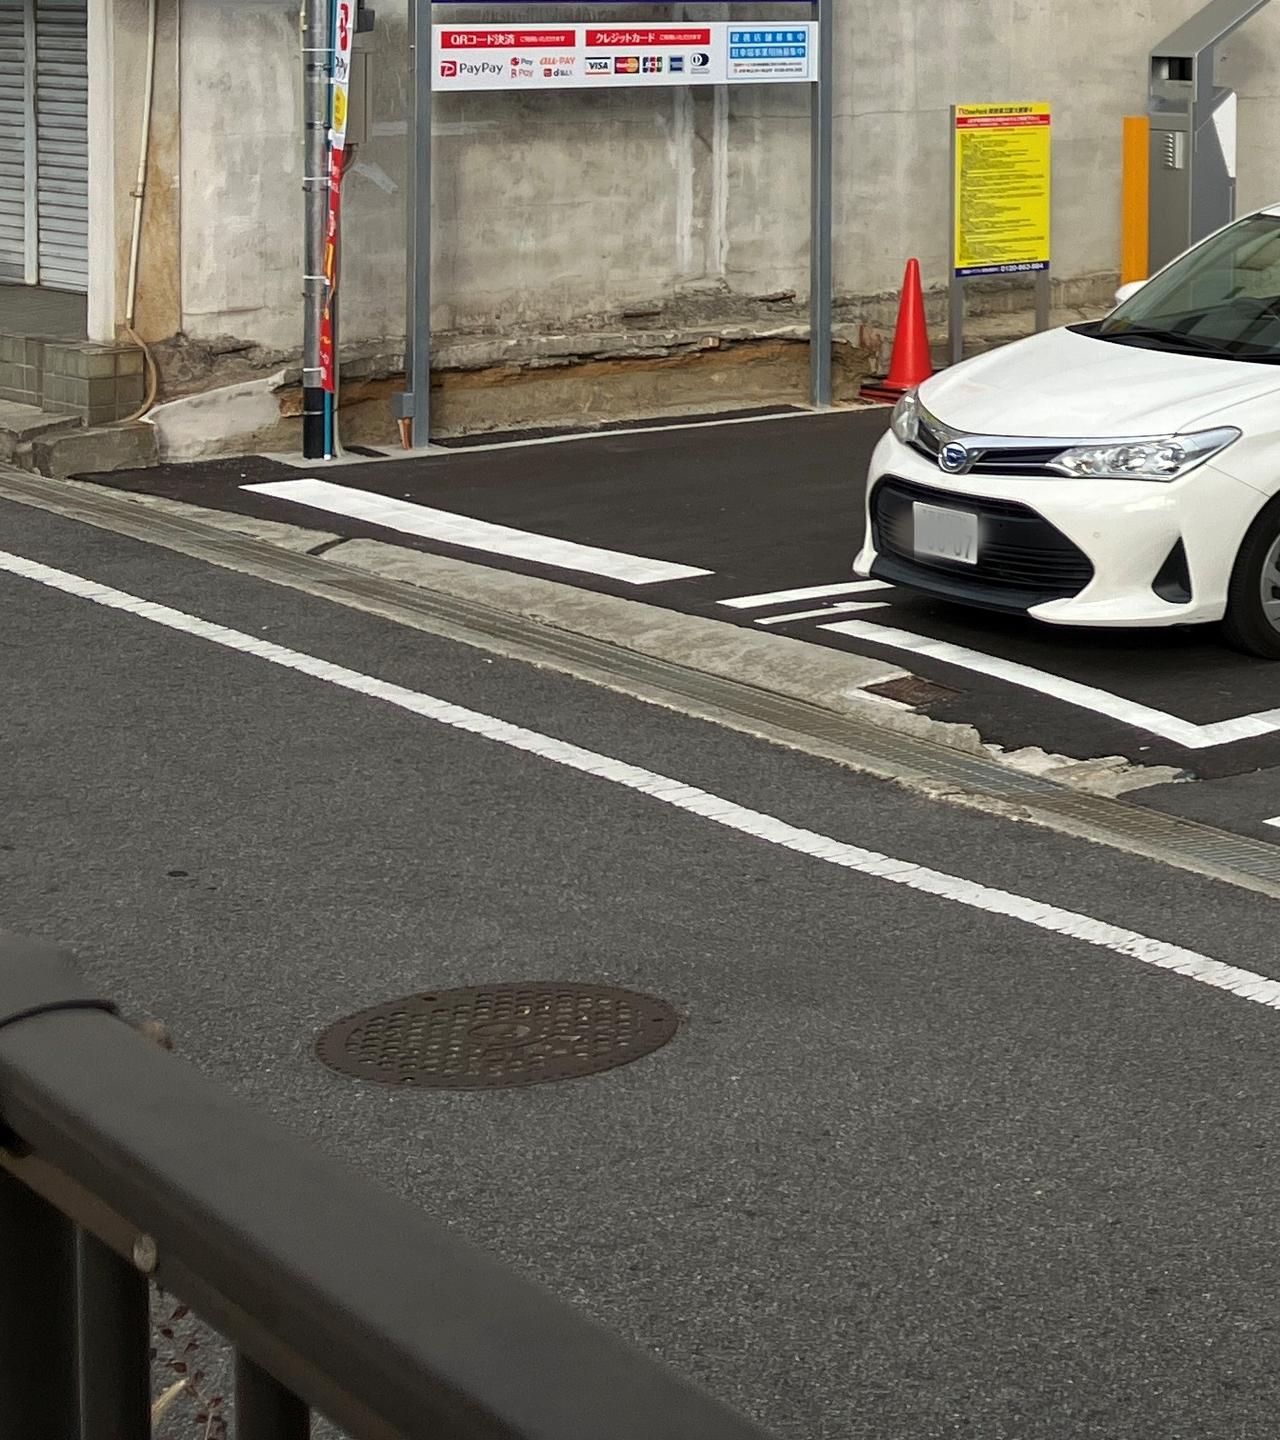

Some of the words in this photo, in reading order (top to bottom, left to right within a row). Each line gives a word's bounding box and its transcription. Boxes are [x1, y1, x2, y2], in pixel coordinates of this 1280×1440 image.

[451, 34, 516, 45] QRコード決済
[596, 32, 655, 44] クレジットカード
[459, 63, 504, 75] PayPay
[588, 61, 608, 70] VISA
